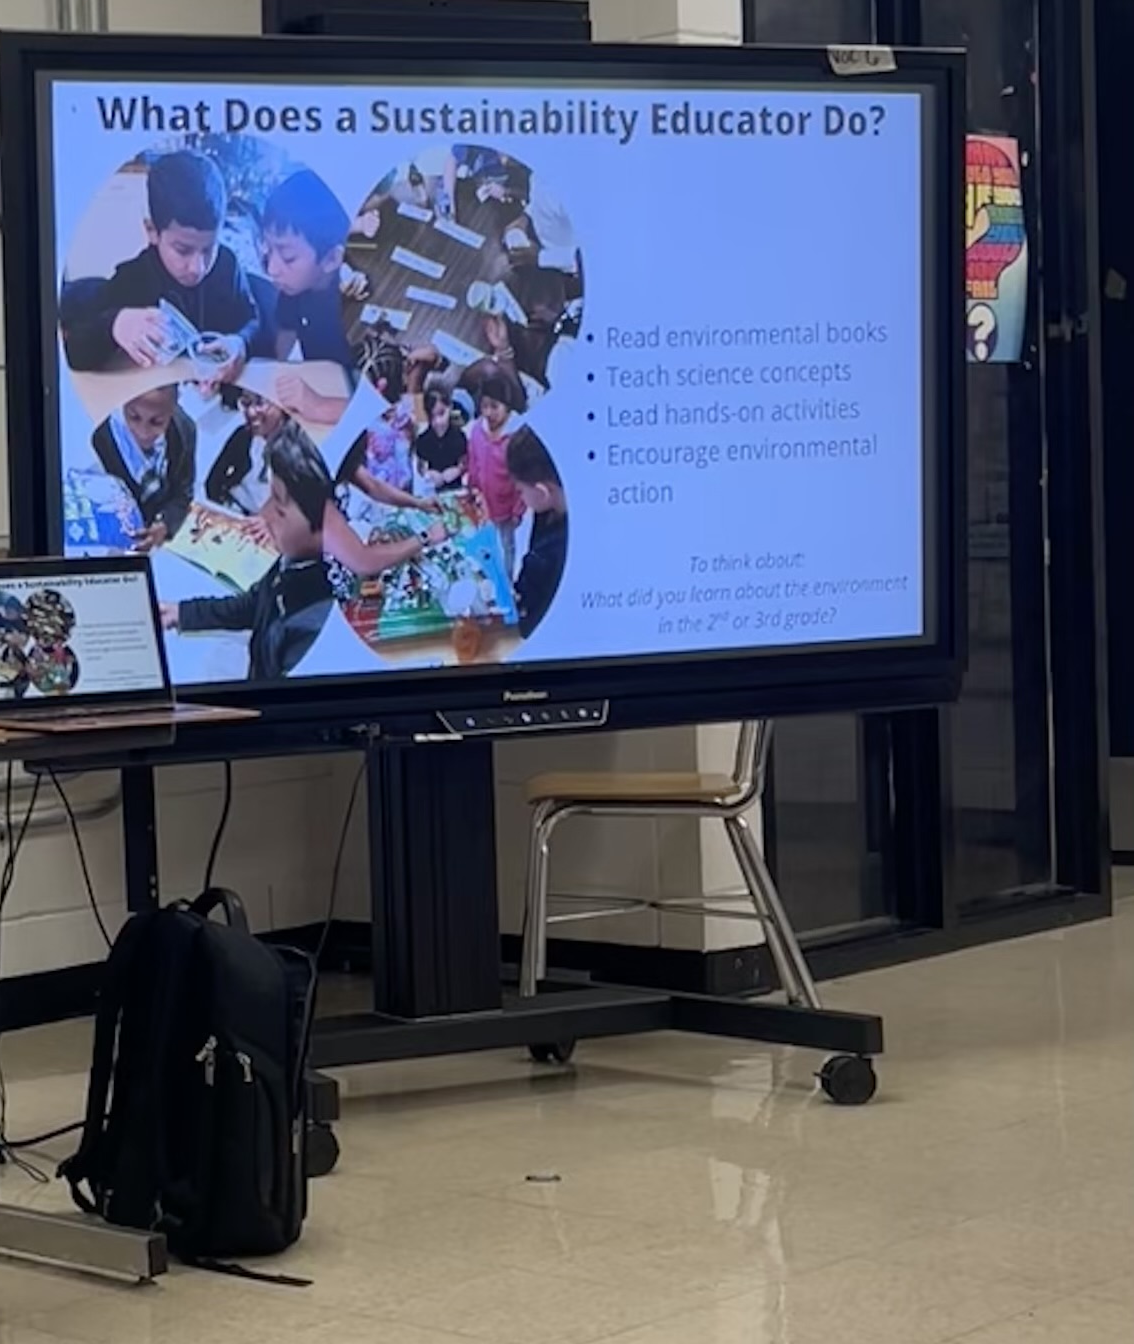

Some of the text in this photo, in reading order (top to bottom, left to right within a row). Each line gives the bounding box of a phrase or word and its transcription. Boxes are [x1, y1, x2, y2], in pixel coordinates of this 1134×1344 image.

[97, 96, 886, 144] What Does a Sustainability Educator Do?
[606, 322, 888, 348] Read environmental books
[606, 361, 852, 388] Teach science concepts
[607, 399, 861, 428] Lead hands-on activities
[608, 434, 878, 469] Encourage environmental
[607, 482, 674, 505] action
[690, 552, 805, 573] To think about:
[580, 574, 908, 611] What did you learn about the environment
[658, 606, 838, 634] in the 2nd or 3rd grade?
